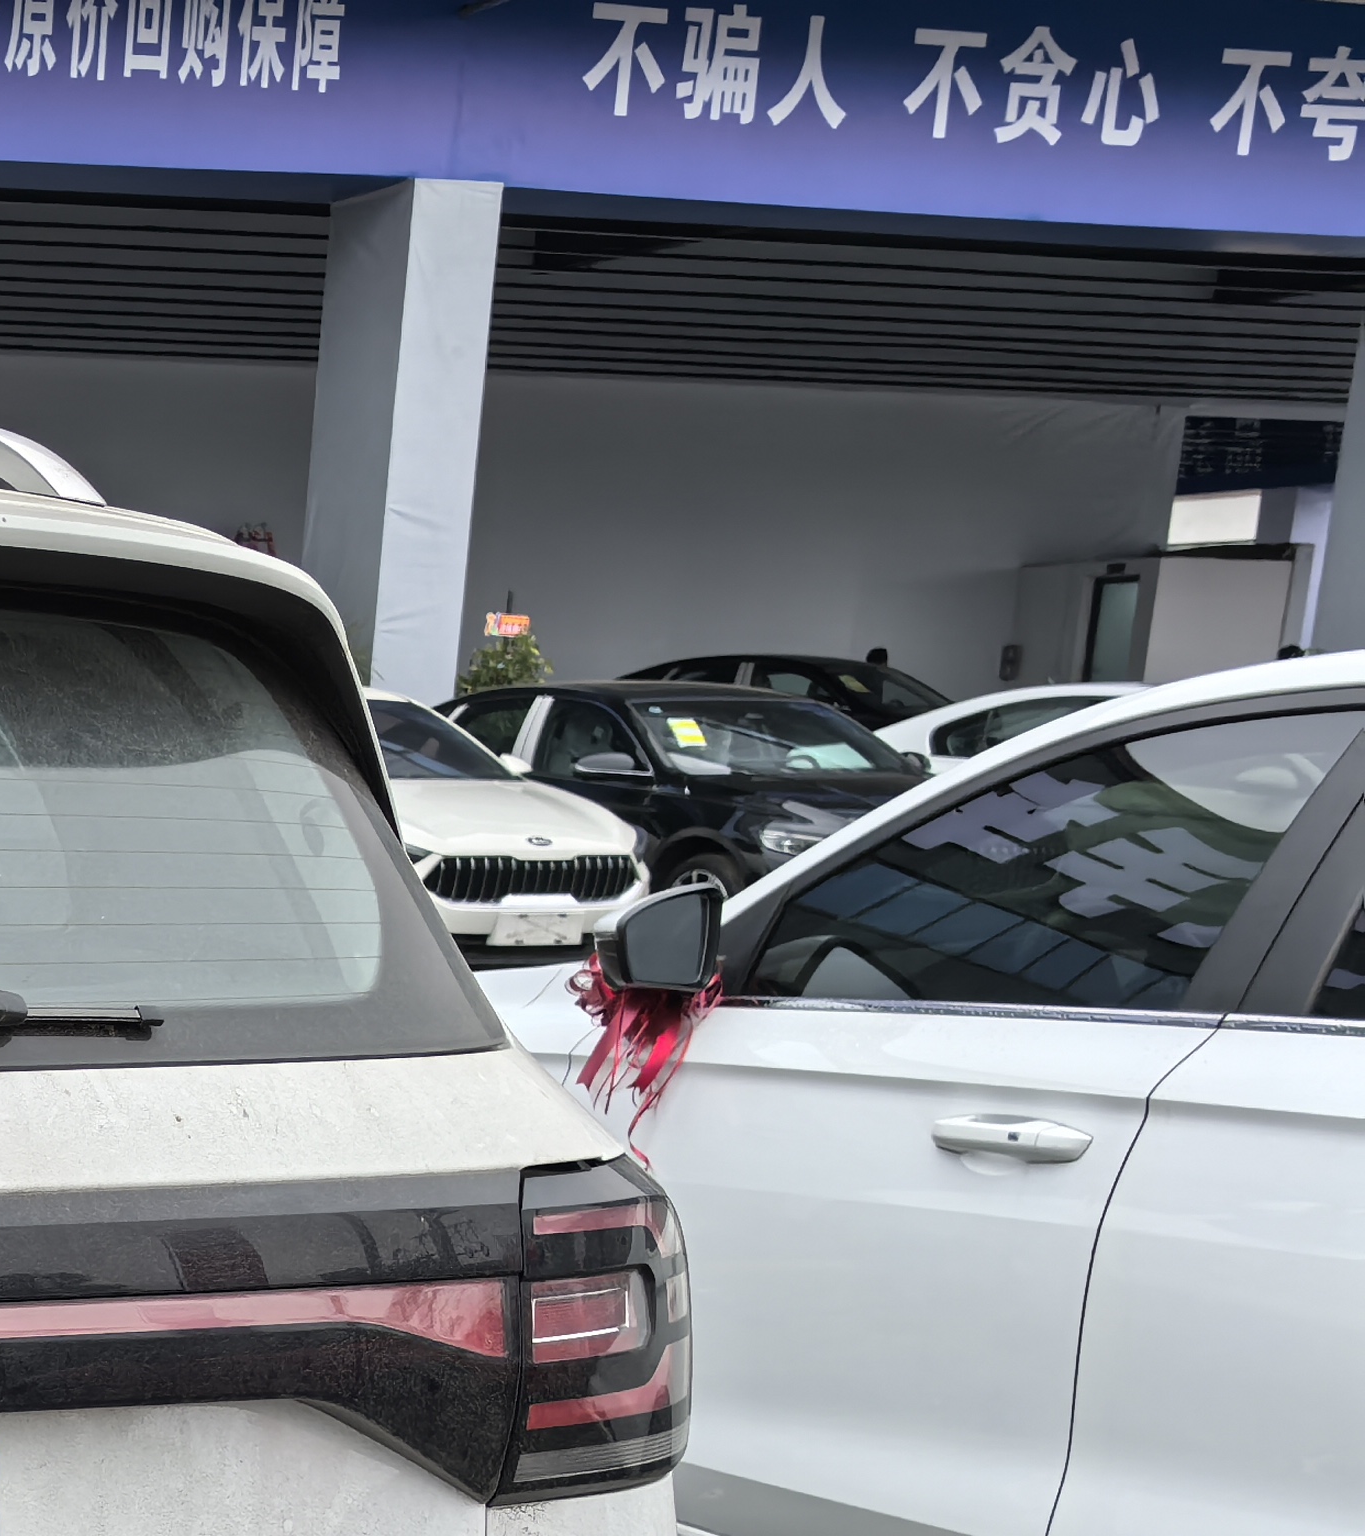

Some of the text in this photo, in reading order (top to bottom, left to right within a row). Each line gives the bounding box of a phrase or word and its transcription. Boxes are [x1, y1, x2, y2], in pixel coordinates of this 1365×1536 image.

[581, 3, 847, 130] 不骗人
[903, 26, 1161, 147] 不贪心
